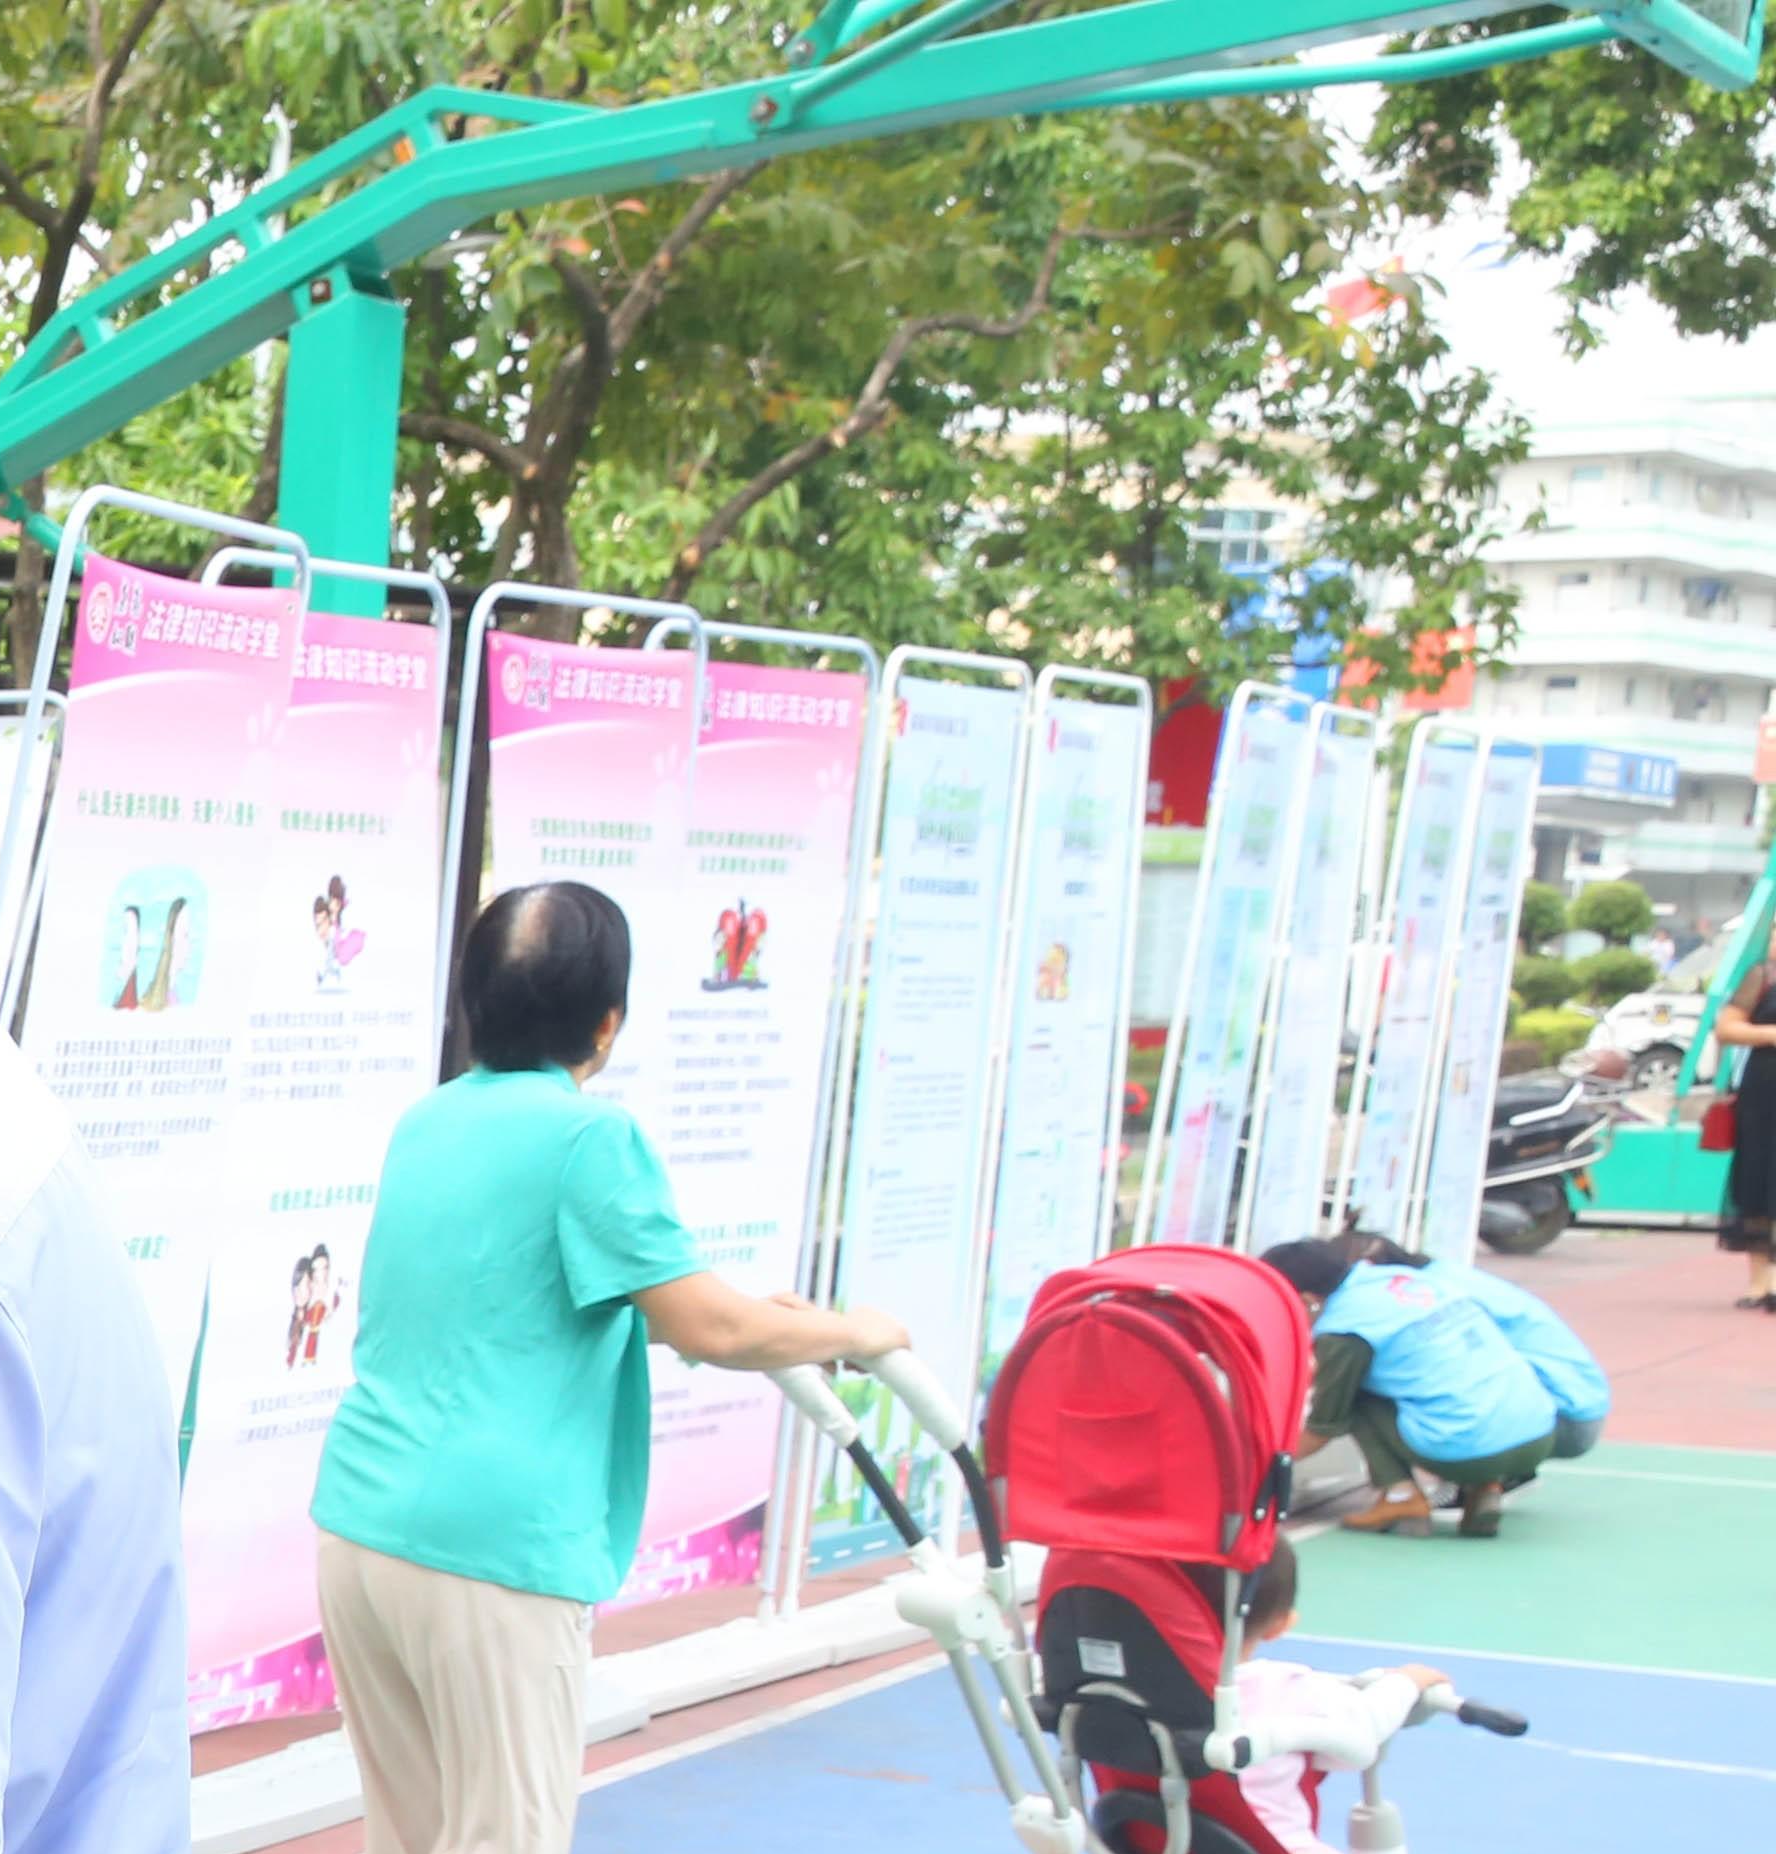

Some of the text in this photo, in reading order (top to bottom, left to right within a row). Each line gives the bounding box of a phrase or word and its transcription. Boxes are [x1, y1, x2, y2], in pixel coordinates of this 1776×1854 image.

[142, 600, 280, 659] 法律知识流动学堂
